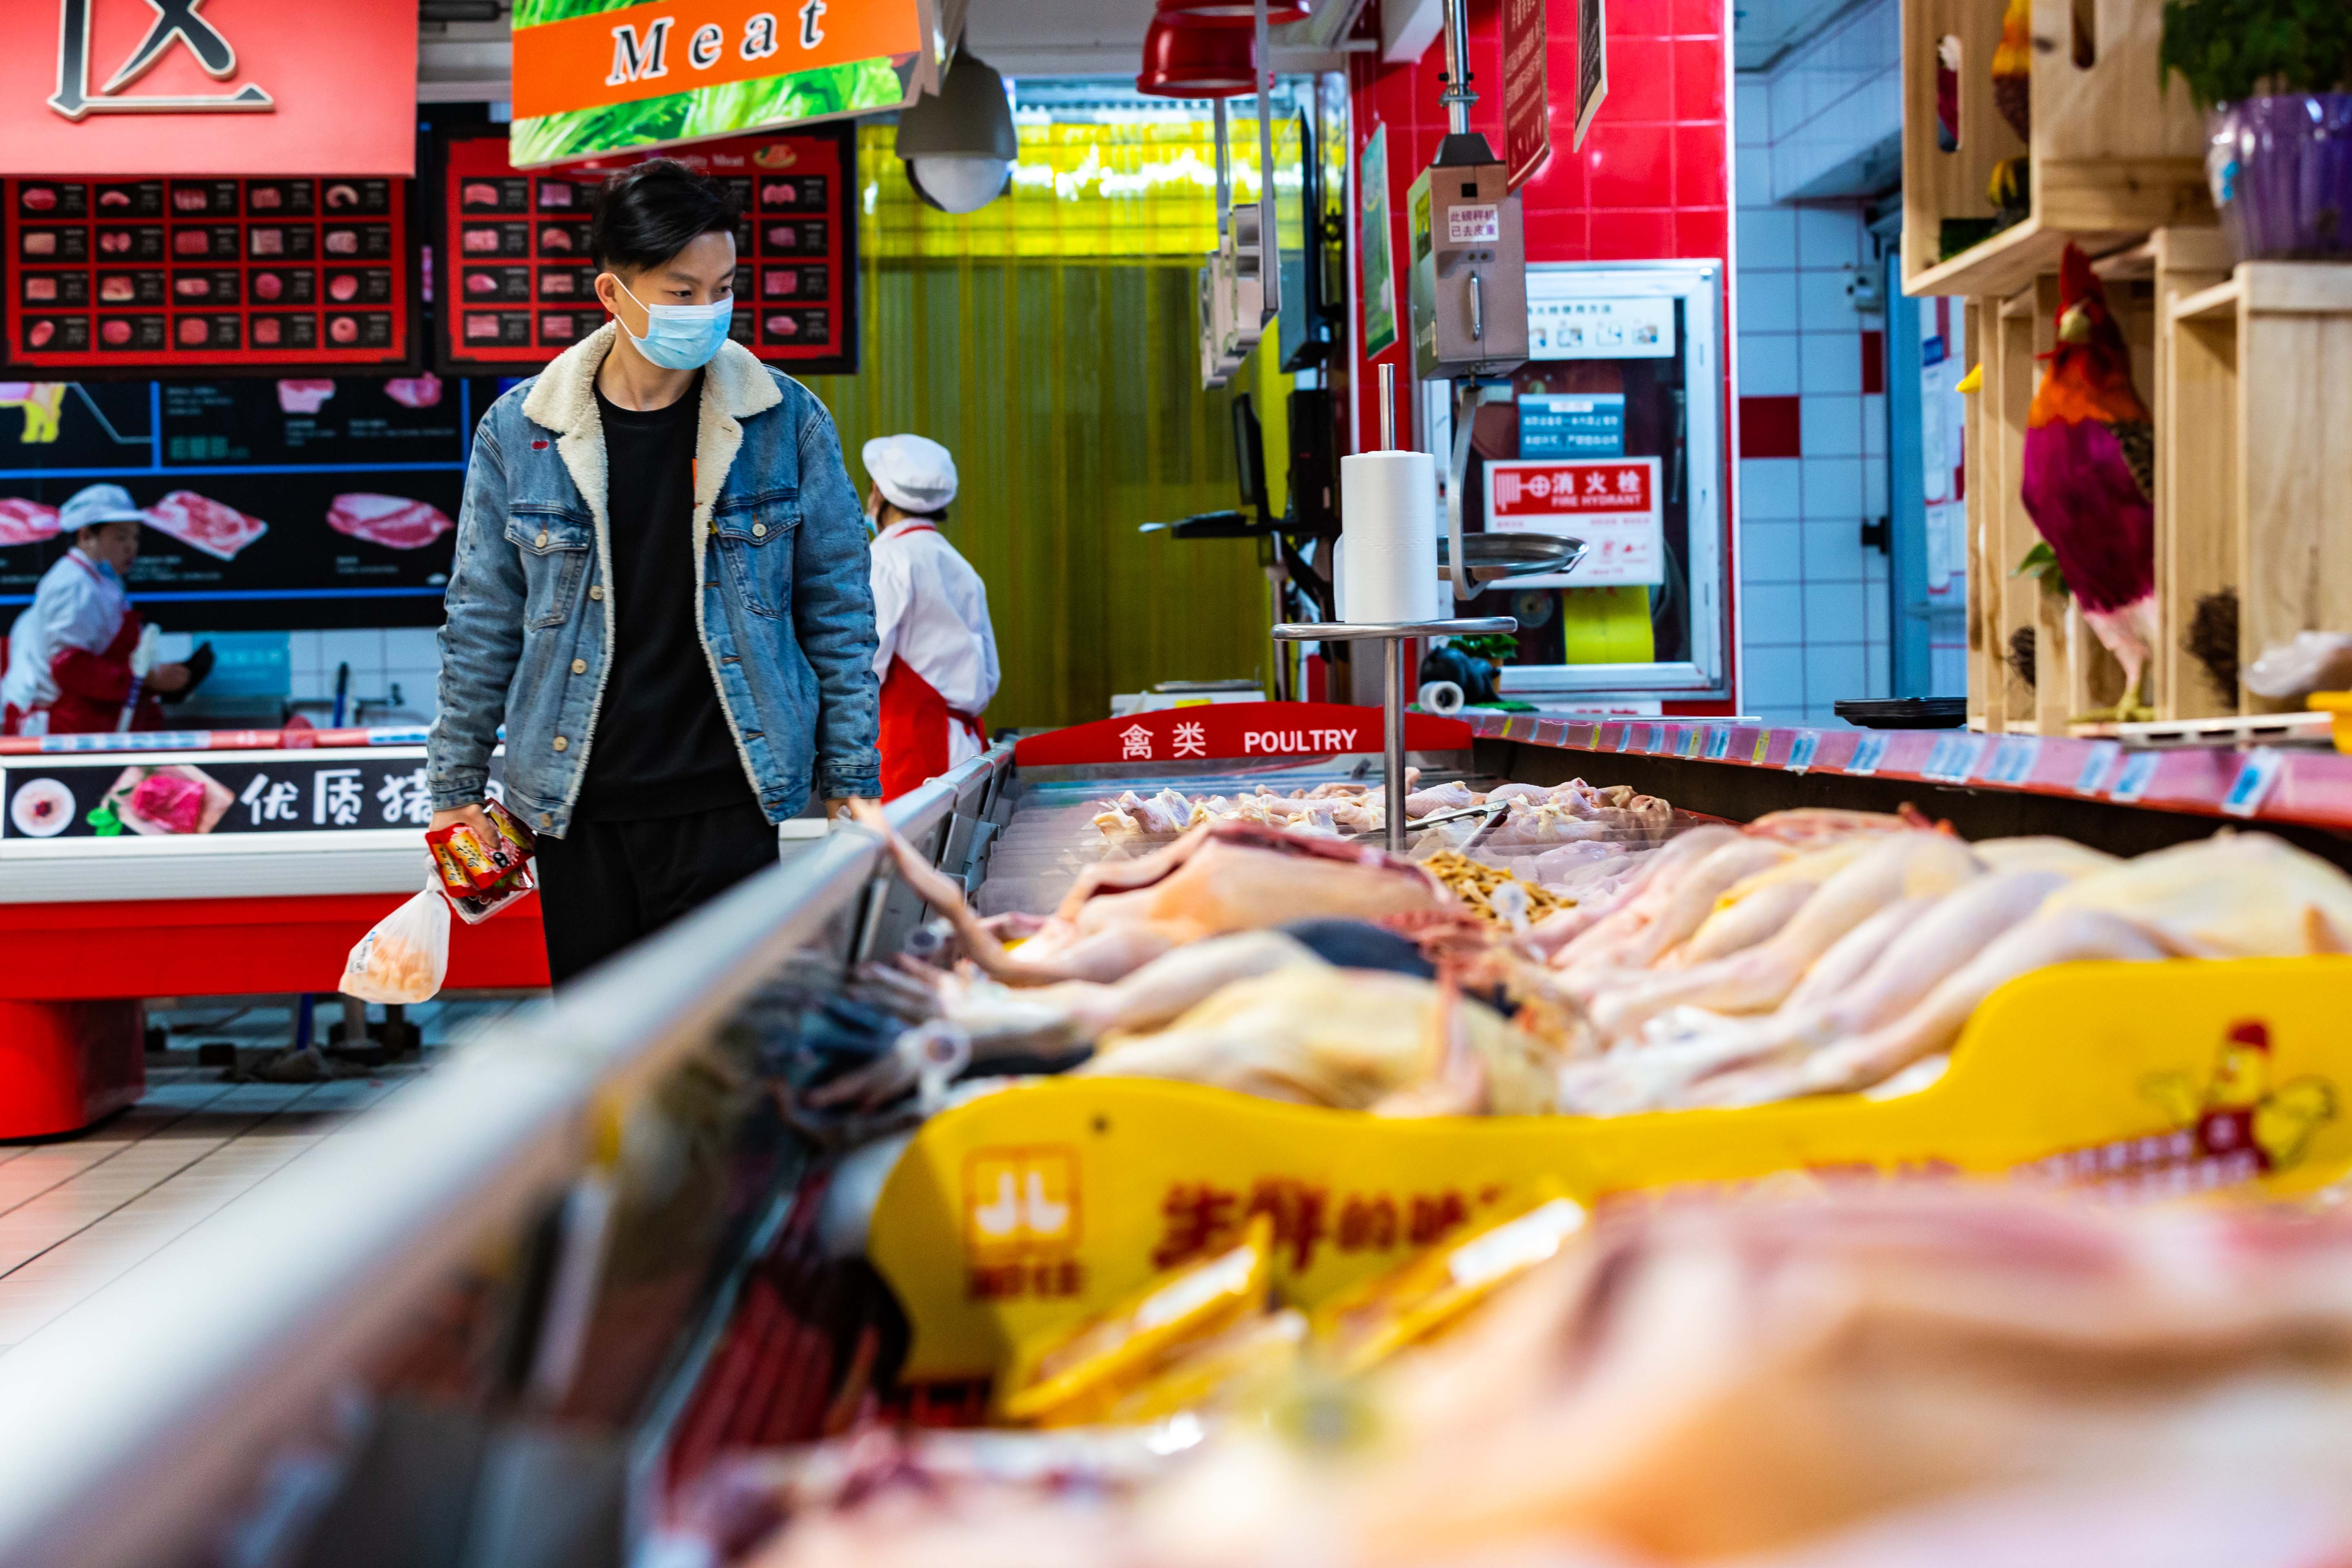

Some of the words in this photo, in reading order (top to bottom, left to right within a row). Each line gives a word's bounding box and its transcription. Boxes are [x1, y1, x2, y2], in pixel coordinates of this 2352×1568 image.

[605, 0, 827, 86] Meat
[1553, 470, 1640, 494] 消火栓
[1552, 495, 1578, 507] FIRE
[1582, 493, 1641, 506] HYDRANT
[1119, 721, 1206, 760] 禽类
[1244, 729, 1357, 753] POULTRY
[240, 768, 505, 826] 优质猪
